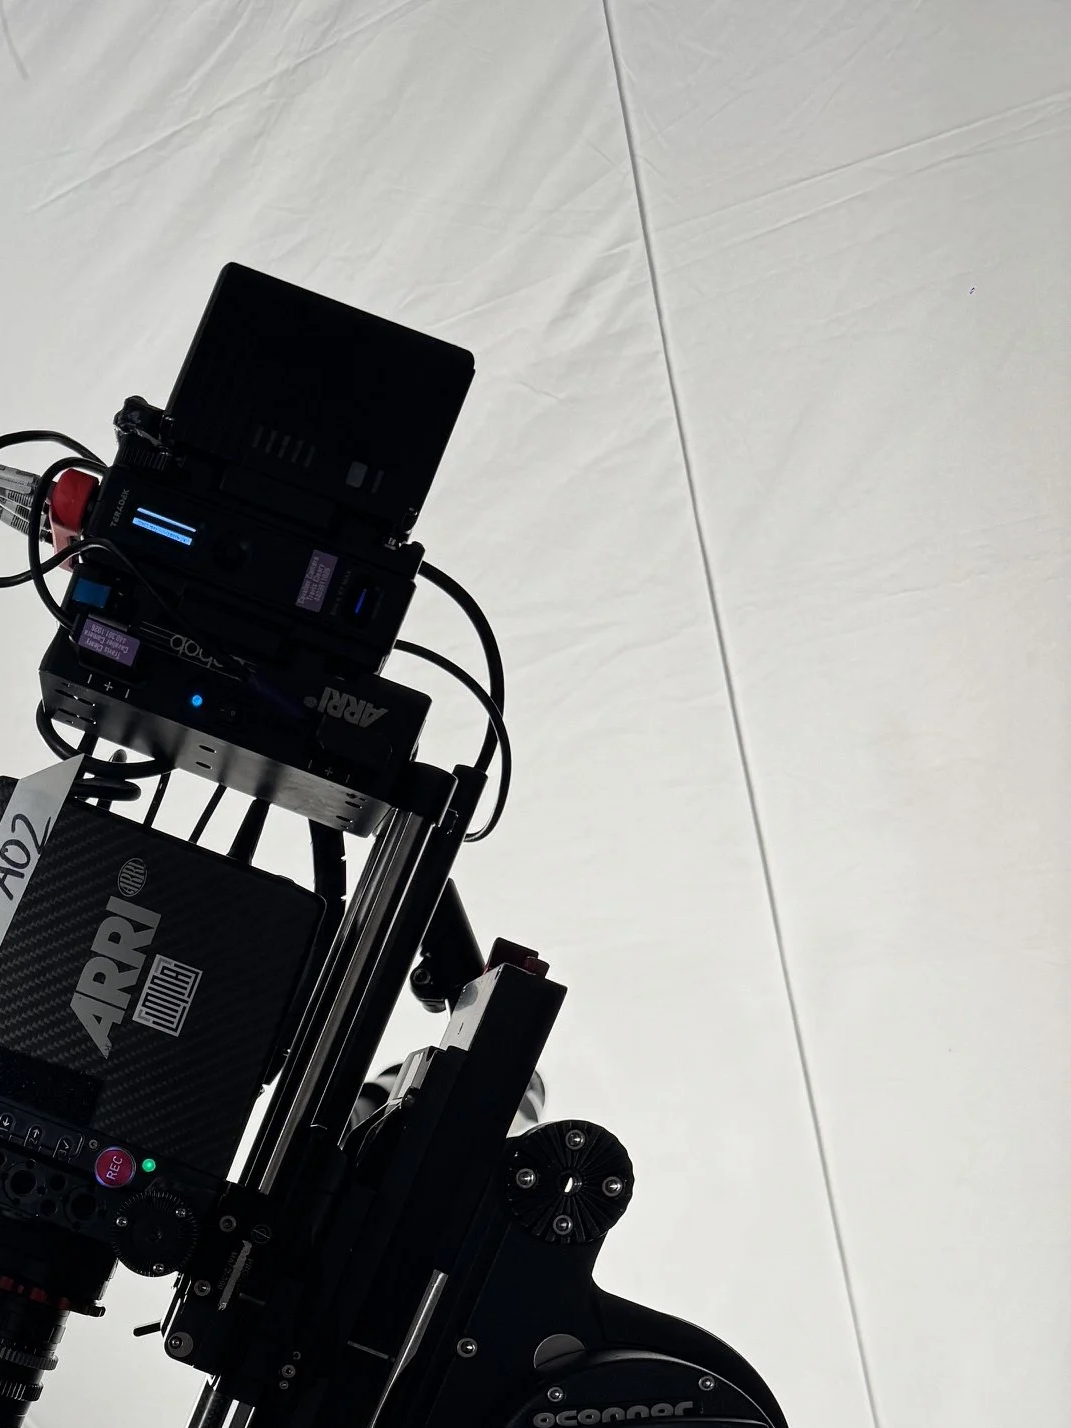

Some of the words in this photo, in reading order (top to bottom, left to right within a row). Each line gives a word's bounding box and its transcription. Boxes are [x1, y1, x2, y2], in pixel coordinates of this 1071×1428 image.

[109, 487, 130, 528] TERADEK
[316, 686, 389, 729] ARRI
[119, 861, 146, 894] ARRI
[69, 895, 163, 1060] ARRI
[105, 1155, 124, 1181] REC
[533, 1401, 693, 1428] oconnor
